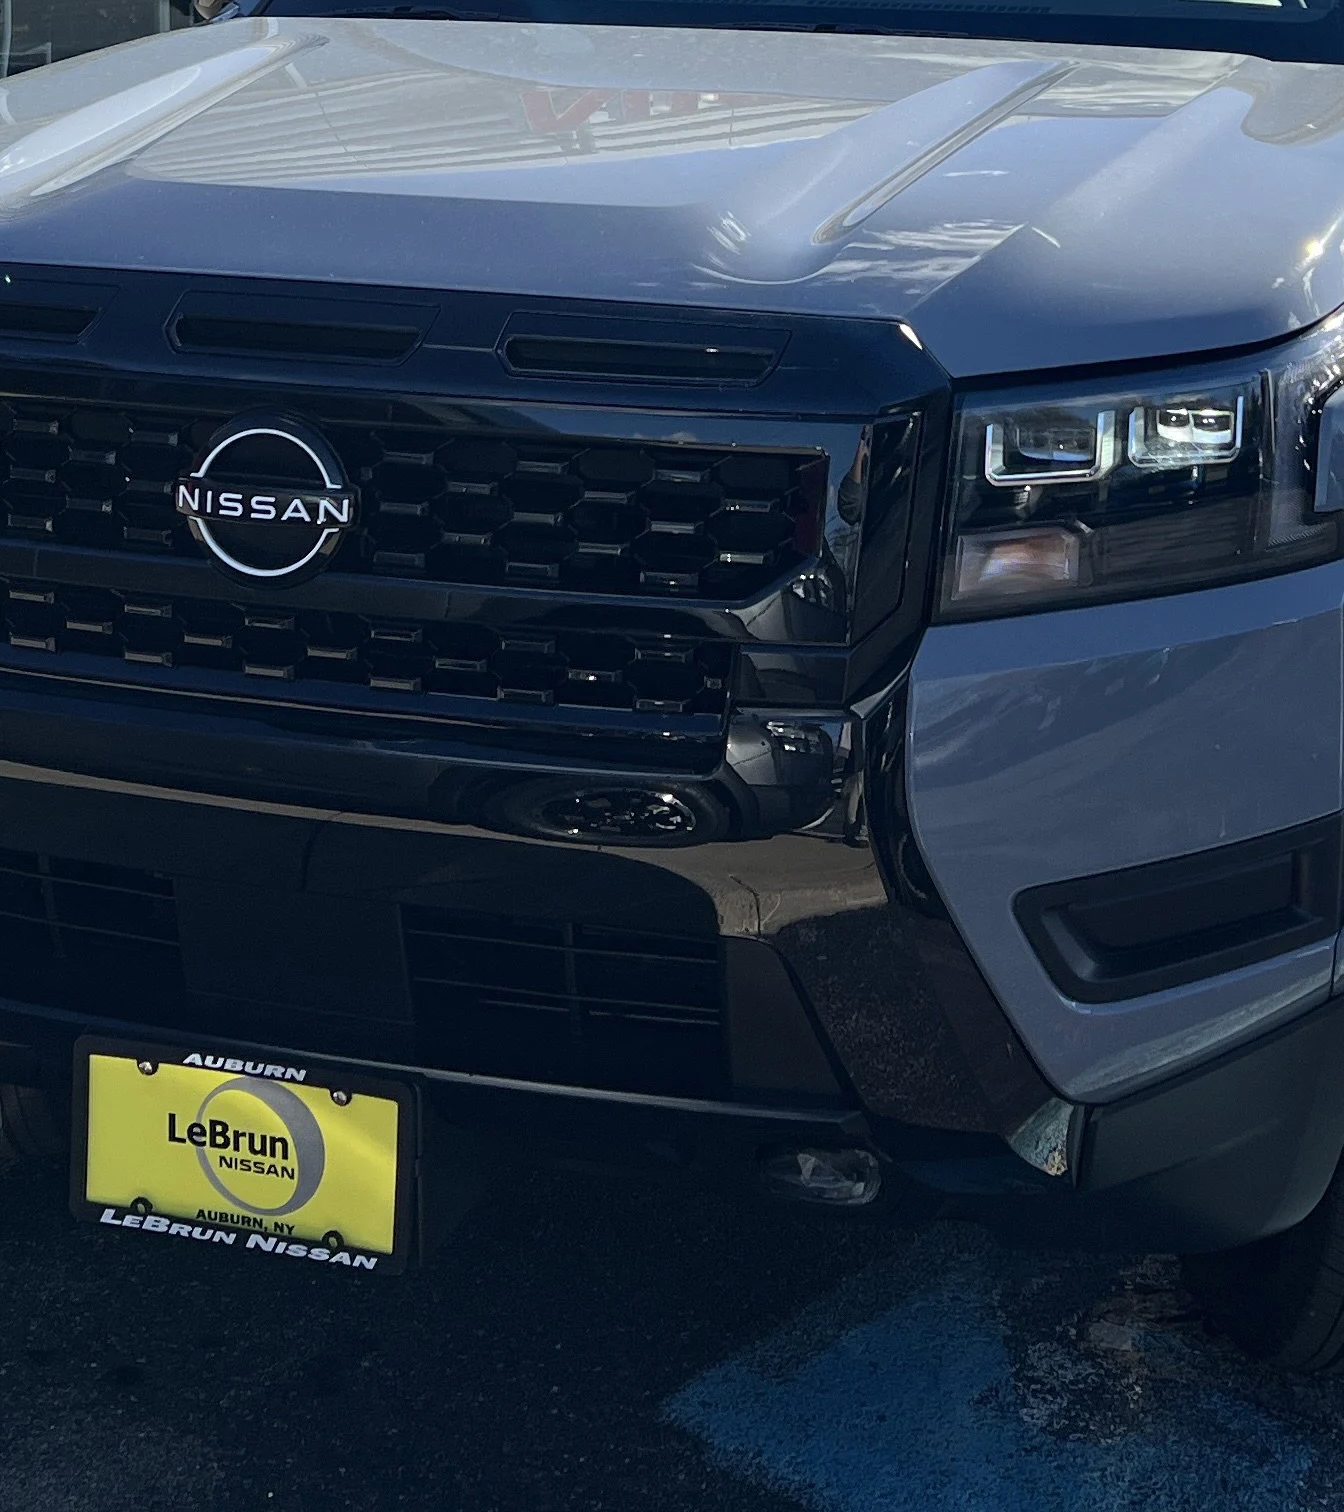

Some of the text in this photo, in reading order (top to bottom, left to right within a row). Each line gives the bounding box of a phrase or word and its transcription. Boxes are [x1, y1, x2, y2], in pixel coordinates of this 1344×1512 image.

[176, 484, 350, 525] NISSAN
[182, 1052, 308, 1082] AUBURN
[167, 1112, 289, 1160] LeBrun
[218, 1156, 296, 1180] NISSAN
[195, 1209, 296, 1235] AUBURN, NY
